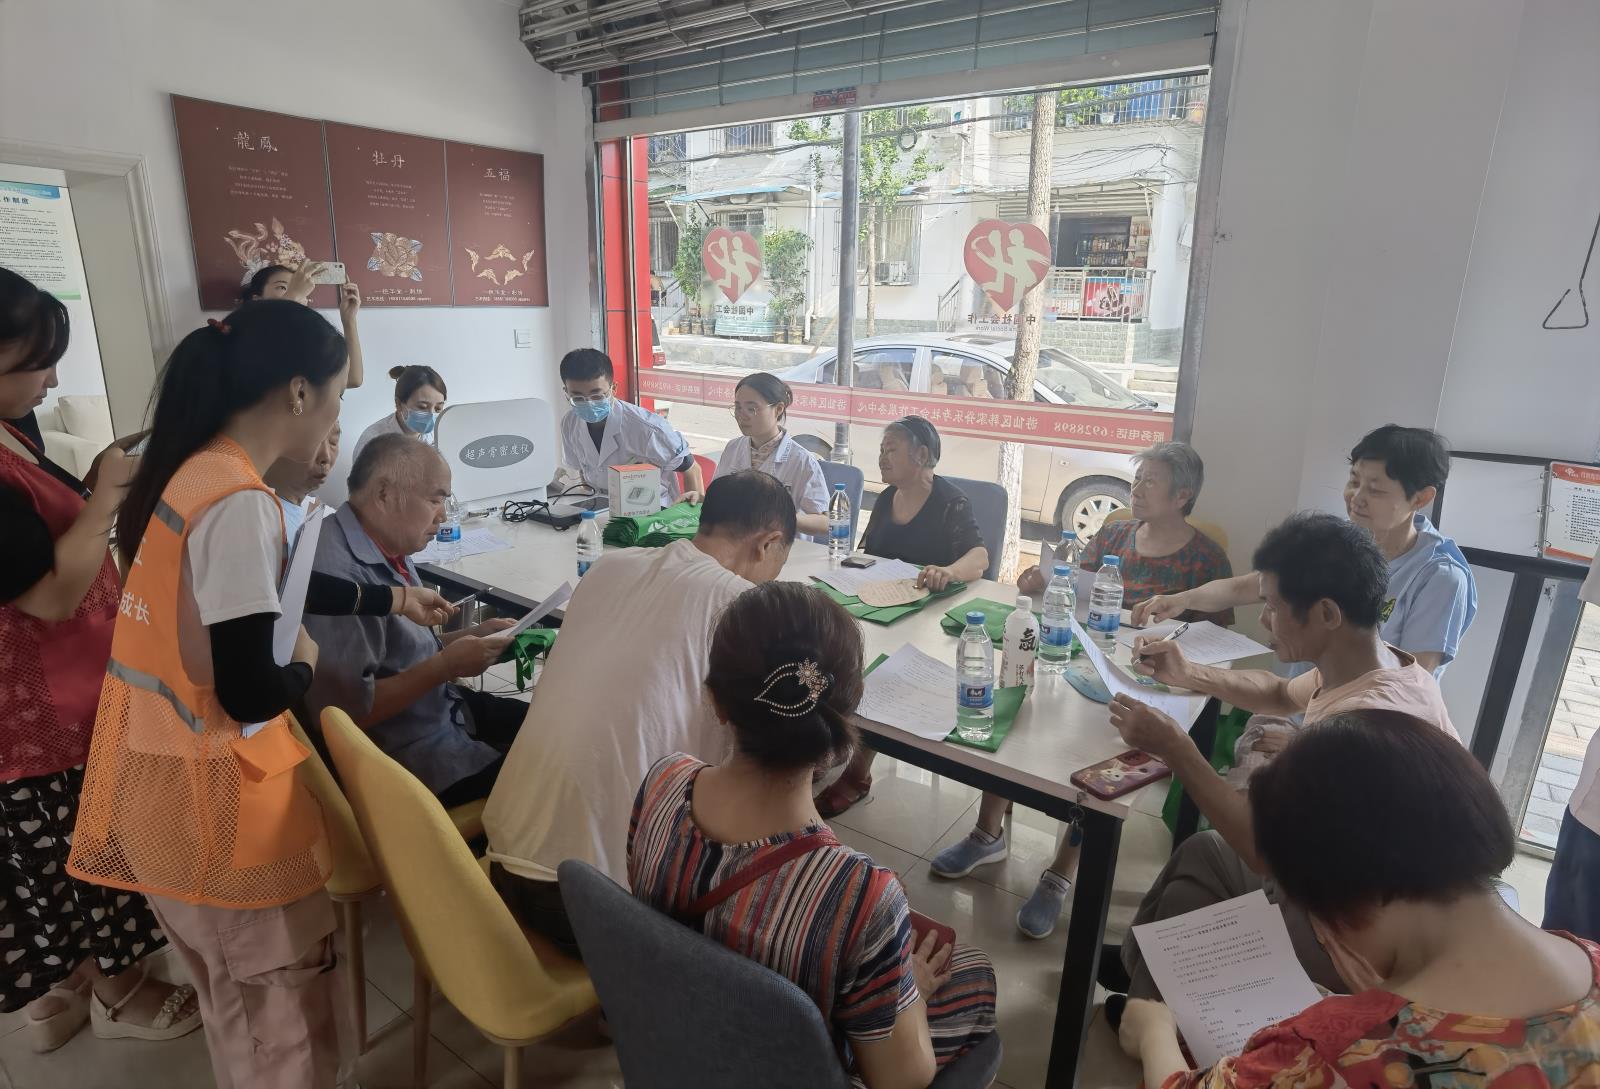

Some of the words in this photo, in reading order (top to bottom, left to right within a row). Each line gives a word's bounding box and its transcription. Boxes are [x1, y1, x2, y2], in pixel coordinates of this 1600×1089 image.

[372, 149, 405, 168] 牡丹
[483, 167, 511, 182] 五福
[465, 442, 529, 460] 超声骨密度仪
